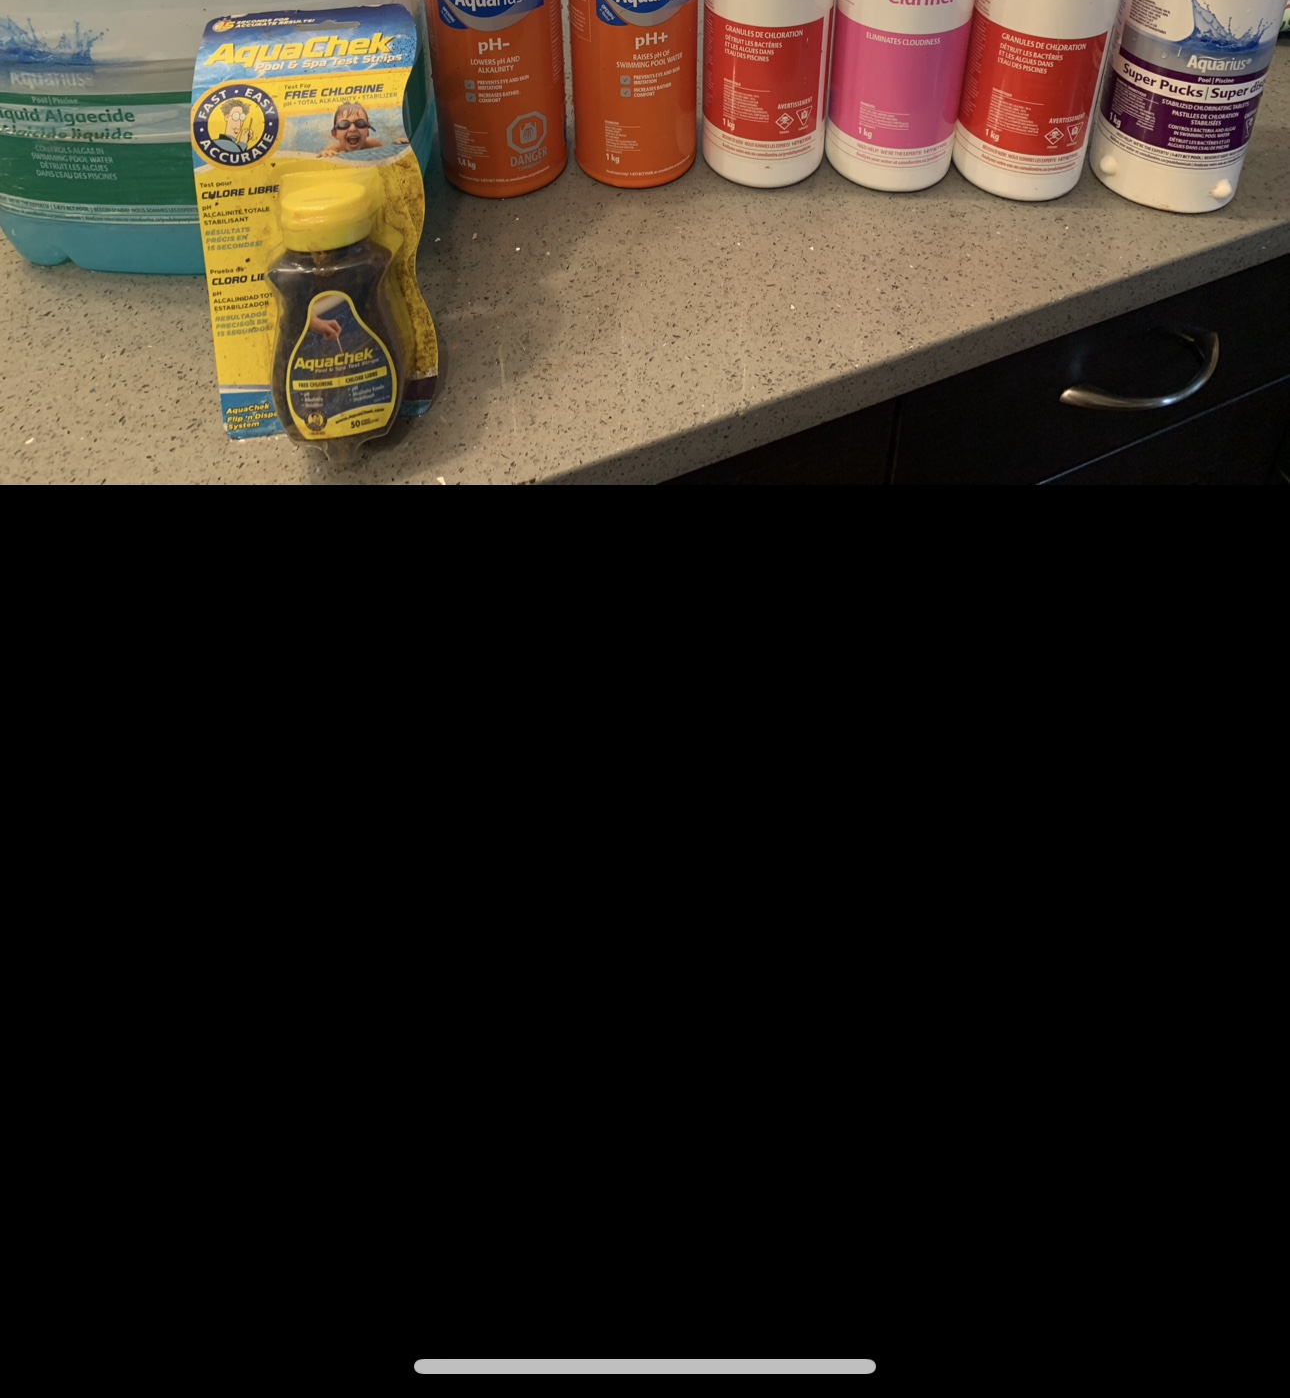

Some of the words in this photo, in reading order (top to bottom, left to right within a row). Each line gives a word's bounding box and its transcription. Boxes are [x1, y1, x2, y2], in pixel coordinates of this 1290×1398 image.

[725, 24, 754, 37] GRANULES
[765, 30, 803, 39] CHLORATION
[634, 32, 668, 50] pH+
[866, 32, 901, 45] ELIMINATES
[902, 38, 941, 47] CLOUDINESS
[1002, 32, 1034, 48] GRANULES
[1046, 43, 1087, 51] CHLORATION
[204, 33, 395, 68] AquaChek
[478, 38, 510, 54] pH-
[739, 45, 758, 54] ALGUES
[254, 62, 284, 72] Pool
[288, 61, 299, 69] &
[302, 58, 326, 69] Spa
[332, 56, 358, 67] Test
[362, 54, 402, 65] Strips
[470, 58, 496, 66] LOWERS
[496, 57, 505, 66] pH
[506, 56, 520, 64] AND
[633, 53, 653, 61] RAISES
[651, 59, 666, 67] POOL
[667, 52, 683, 63] WATER
[747, 54, 769, 62] PISCINES
[1006, 52, 1014, 60] LES
[1015, 56, 1036, 66] ALGUES
[478, 65, 514, 74] ALKALINITY
[1011, 62, 1022, 70] DES
[1023, 65, 1047, 74] PISCINES
[1123, 63, 1157, 87] Super
[1159, 78, 1203, 98] Pucks
[1210, 86, 1246, 101] Super
[284, 89, 317, 100] FREE
[321, 84, 384, 97] CHLORINE
[362, 92, 397, 100] STABILIZER
[199, 90, 227, 120] FAST
[244, 87, 276, 115] EASY
[1162, 98, 1193, 110] STABILIZED
[0, 108, 40, 123] iquid
[45, 108, 135, 126] Algaecide
[1172, 110, 1199, 119] PASTILLES
[1208, 112, 1239, 120] CHLORATION
[727, 119, 735, 131] kg
[71, 127, 133, 142] liquide
[863, 129, 872, 139] kg
[990, 130, 1000, 142] kg
[200, 133, 274, 164] ACCURATE
[69, 155, 88, 163] POOL
[510, 146, 547, 167] DANGER
[611, 154, 620, 164] kg
[82, 164, 108, 172] ALGUES
[467, 160, 476, 170] kg
[36, 170, 55, 178] DANS
[248, 185, 279, 195] LIBRE
[204, 217, 248, 225] STABILISANT
[212, 275, 247, 286] CLORO
[214, 301, 269, 311] ESTABILIZADOR
[294, 348, 373, 371] AquaChek
[226, 403, 270, 415] AquaChek
[228, 422, 259, 431] System
[351, 420, 360, 428] 50
